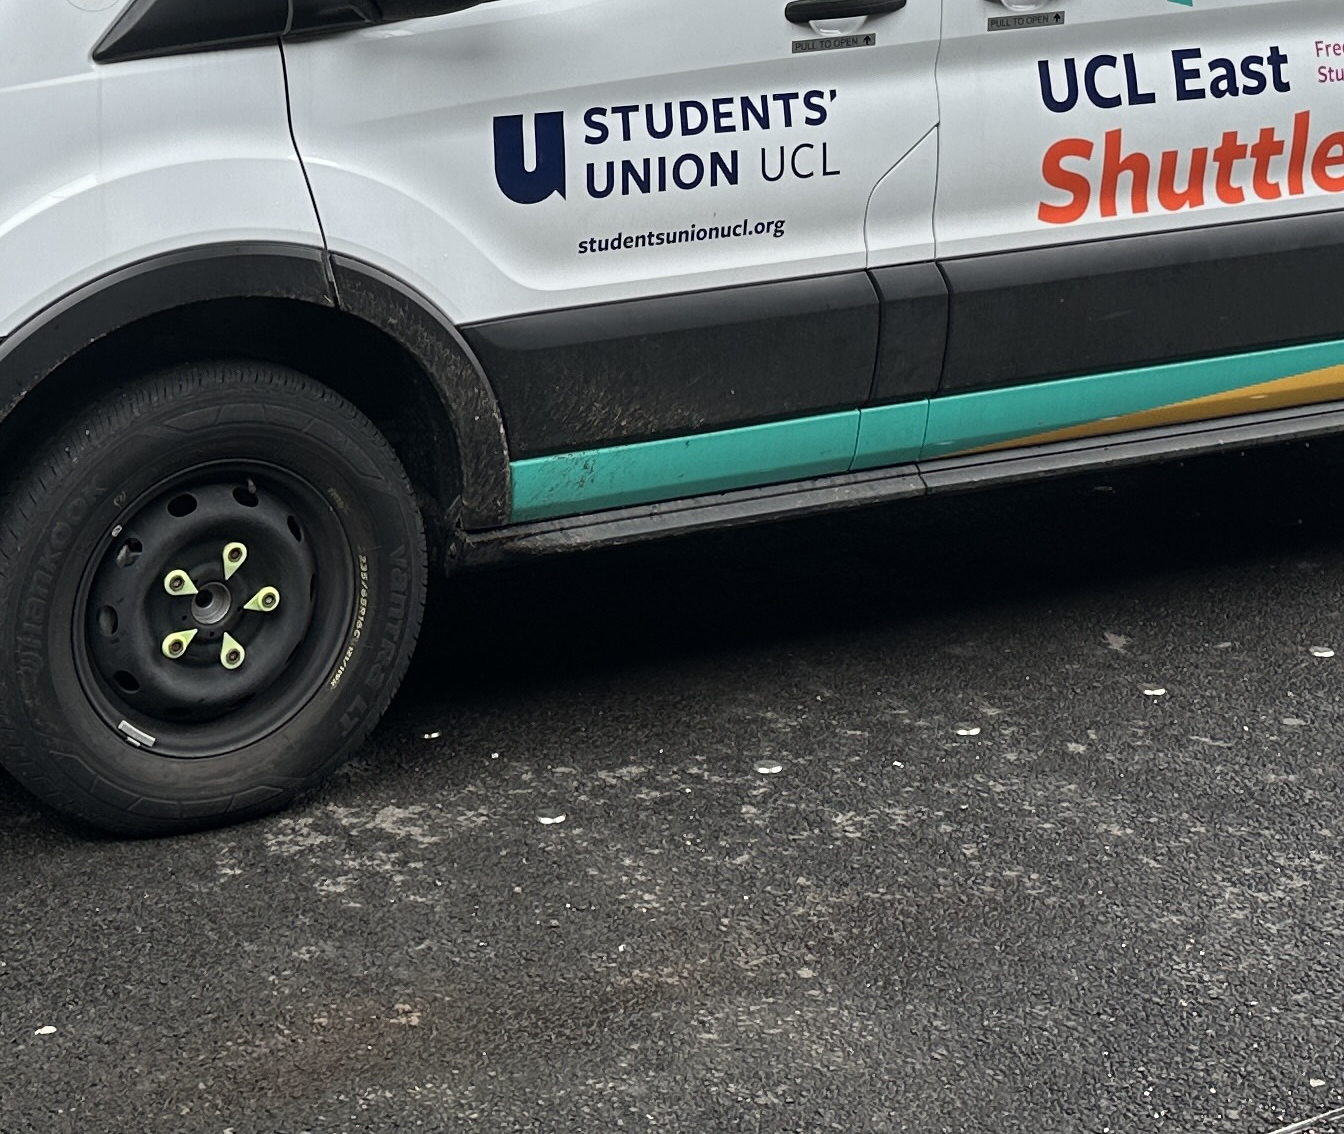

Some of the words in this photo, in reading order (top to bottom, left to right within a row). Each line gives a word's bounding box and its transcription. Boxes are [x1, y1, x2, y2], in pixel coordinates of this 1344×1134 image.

[795, 42, 817, 51] PULL
[819, 39, 832, 49] TO
[833, 37, 858, 47] OPEN
[990, 19, 1011, 28] PULL
[1013, 17, 1025, 26] TO
[1026, 15, 1049, 24] OPEN
[1037, 53, 1156, 114] UCL
[1171, 45, 1291, 102] East
[583, 88, 838, 145] STUDENTS'
[585, 149, 739, 199] UNION
[760, 142, 841, 182] UCL
[577, 218, 786, 255] studentsunionucl.org
